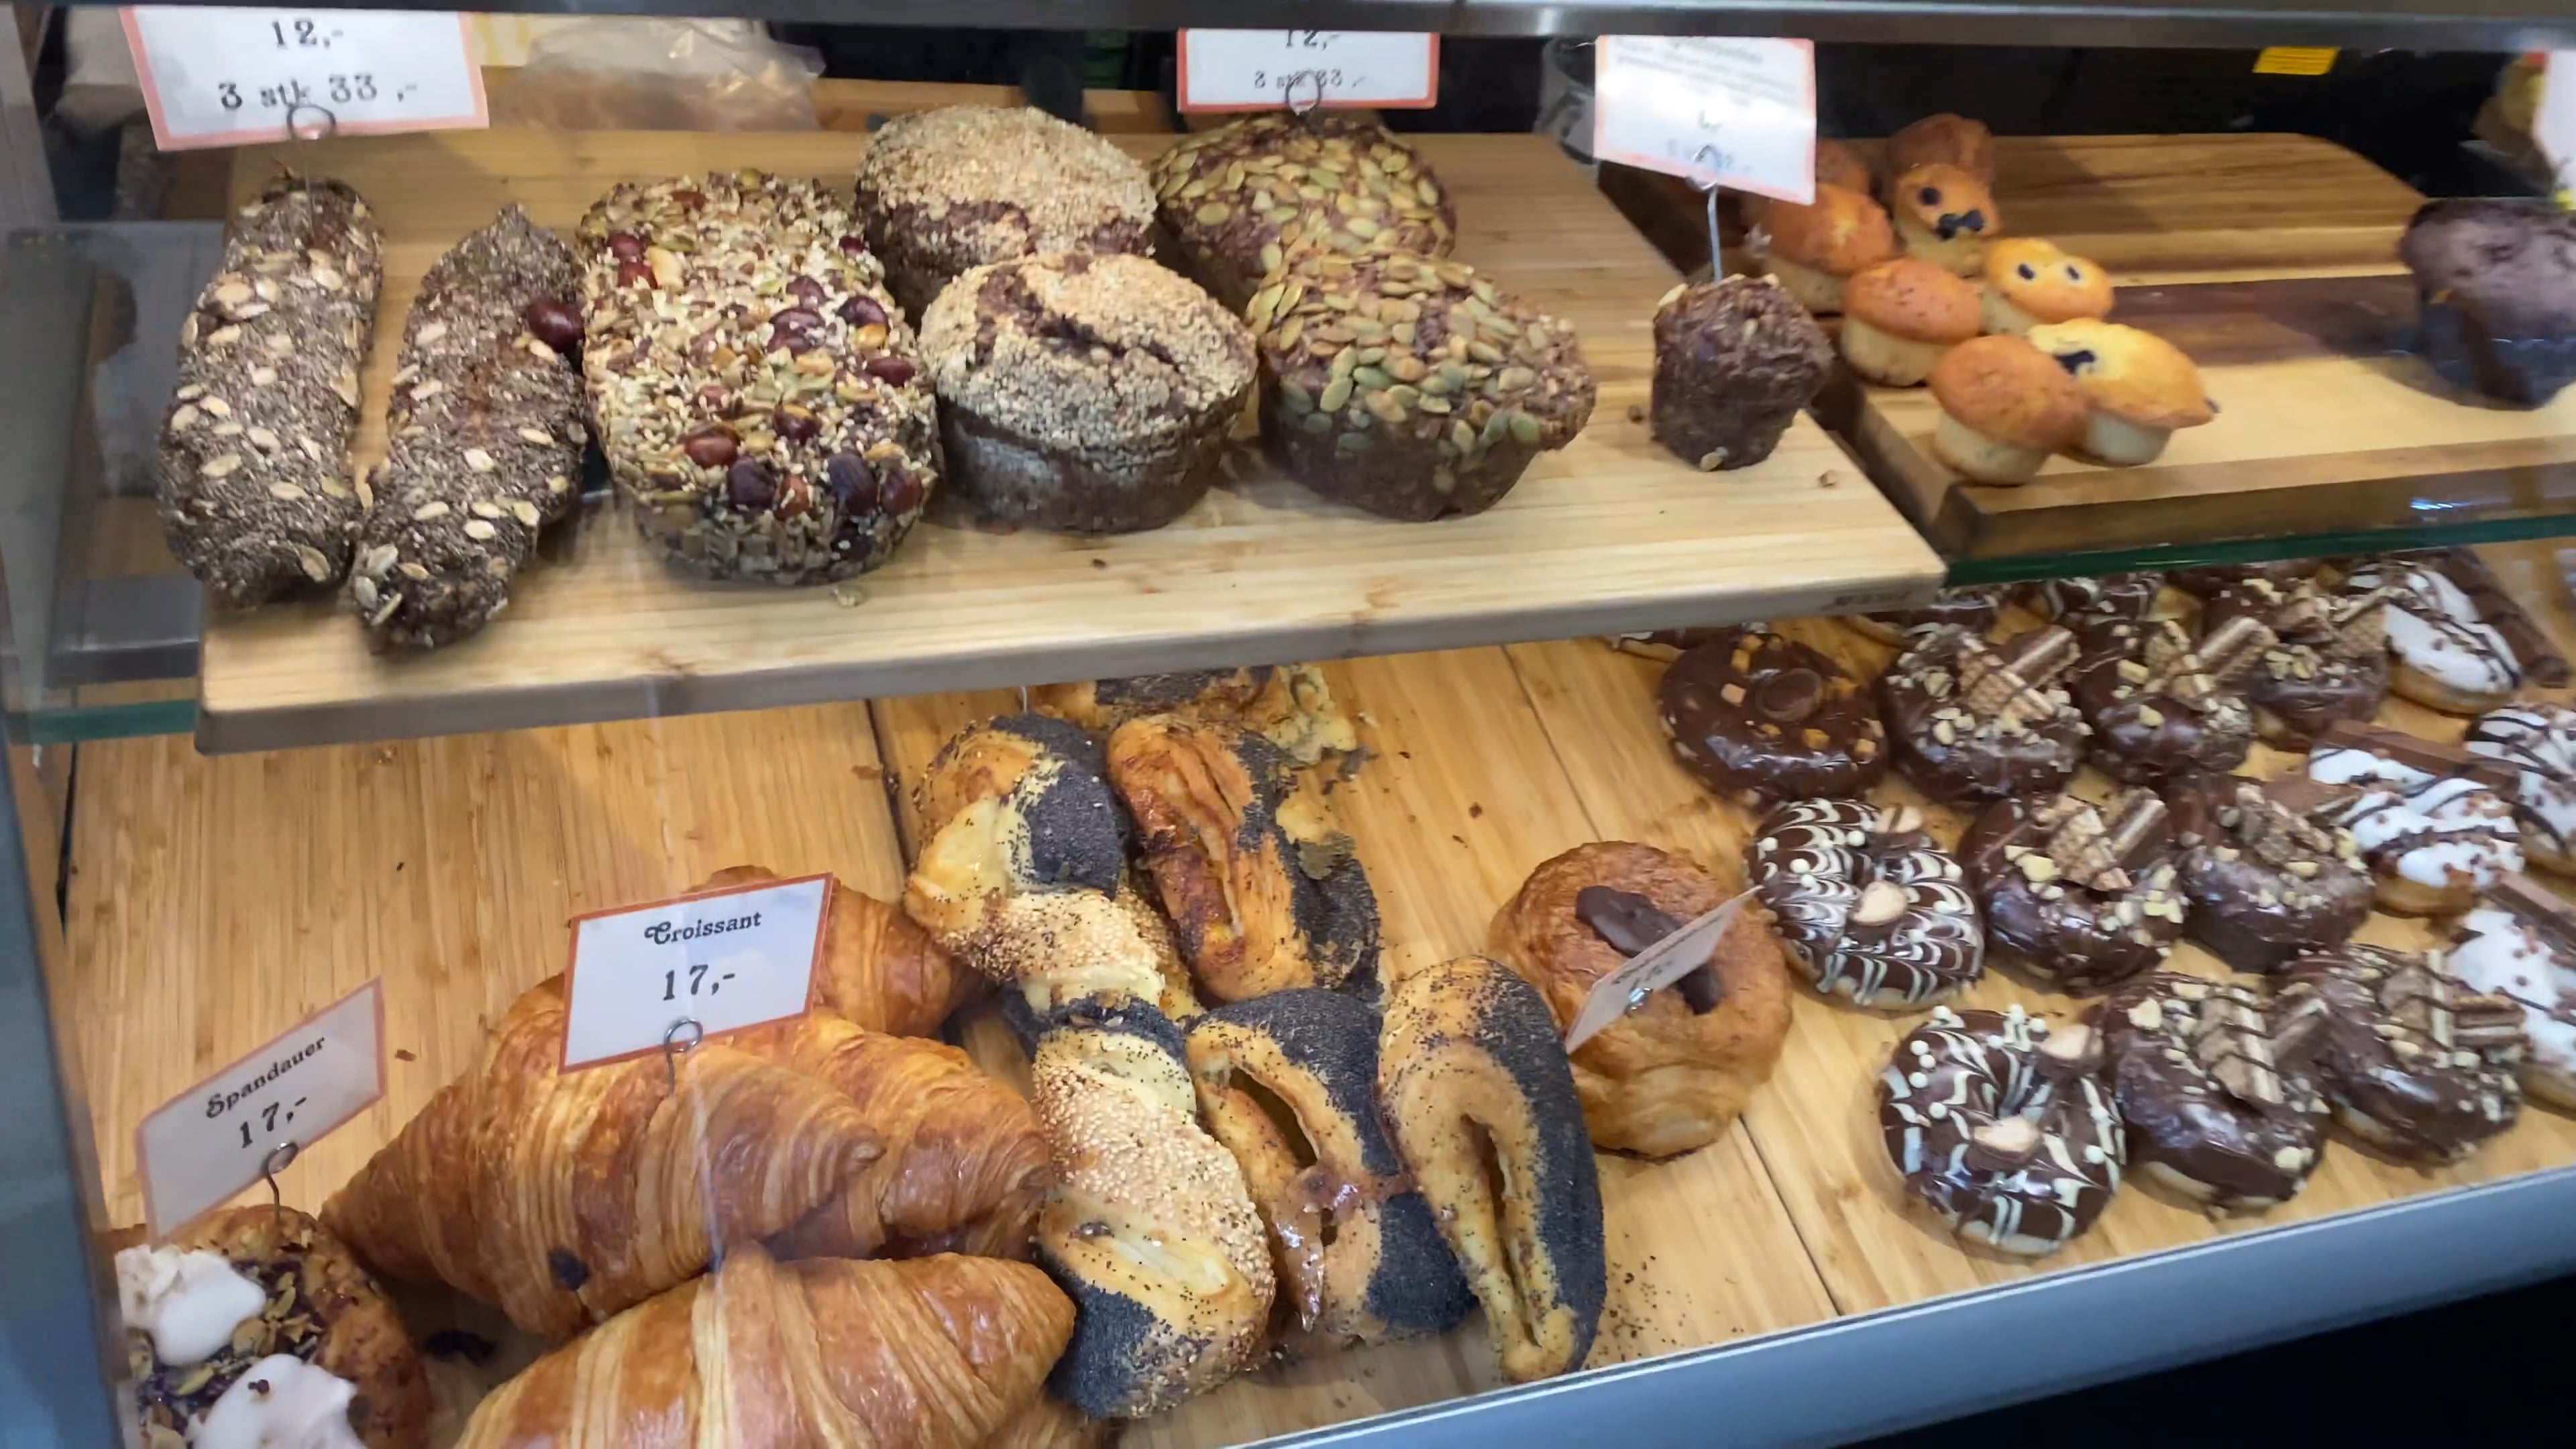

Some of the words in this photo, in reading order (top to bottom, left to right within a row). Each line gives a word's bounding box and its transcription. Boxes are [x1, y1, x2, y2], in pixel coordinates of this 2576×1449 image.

[217, 80, 243, 110] 3
[260, 79, 310, 107] stk
[328, 73, 378, 104] 33
[643, 911, 761, 945] Croissant
[205, 1036, 325, 1119] Spandauer
